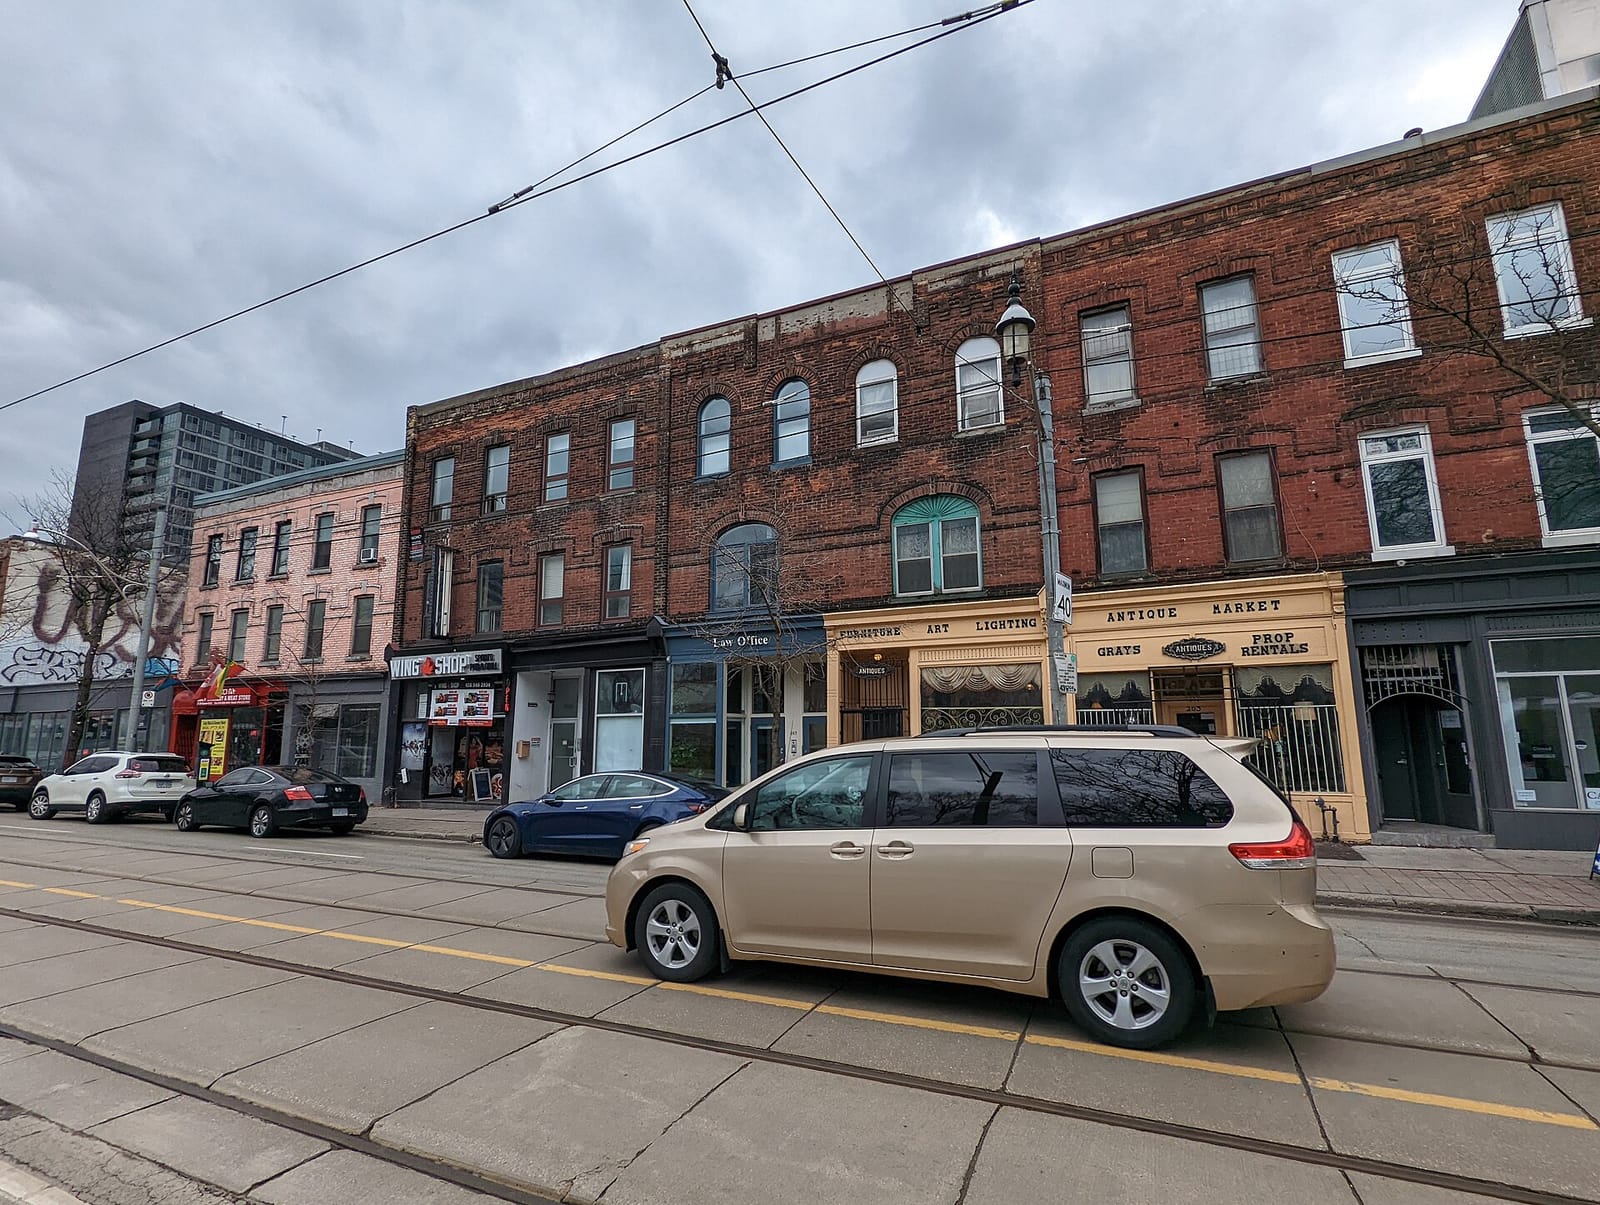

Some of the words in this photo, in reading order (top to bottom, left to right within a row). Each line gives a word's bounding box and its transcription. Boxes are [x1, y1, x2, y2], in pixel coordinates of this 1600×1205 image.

[1057, 595, 1071, 618] 40
[1107, 608, 1177, 622] ANTIQUE
[1213, 600, 1280, 614] MARKET
[840, 627, 900, 638] FURNITURE
[927, 624, 949, 634] ART
[976, 618, 1037, 631] LIGHTING
[737, 635, 769, 646] Office
[1252, 632, 1294, 645] PROP
[1097, 645, 1141, 656] GRAYS
[1175, 644, 1213, 653] ANTIQUES
[1241, 643, 1309, 656] RENTALS
[390, 659, 420, 677] WING
[435, 655, 467, 674] SHOP
[859, 667, 886, 675] ANTIQUES
